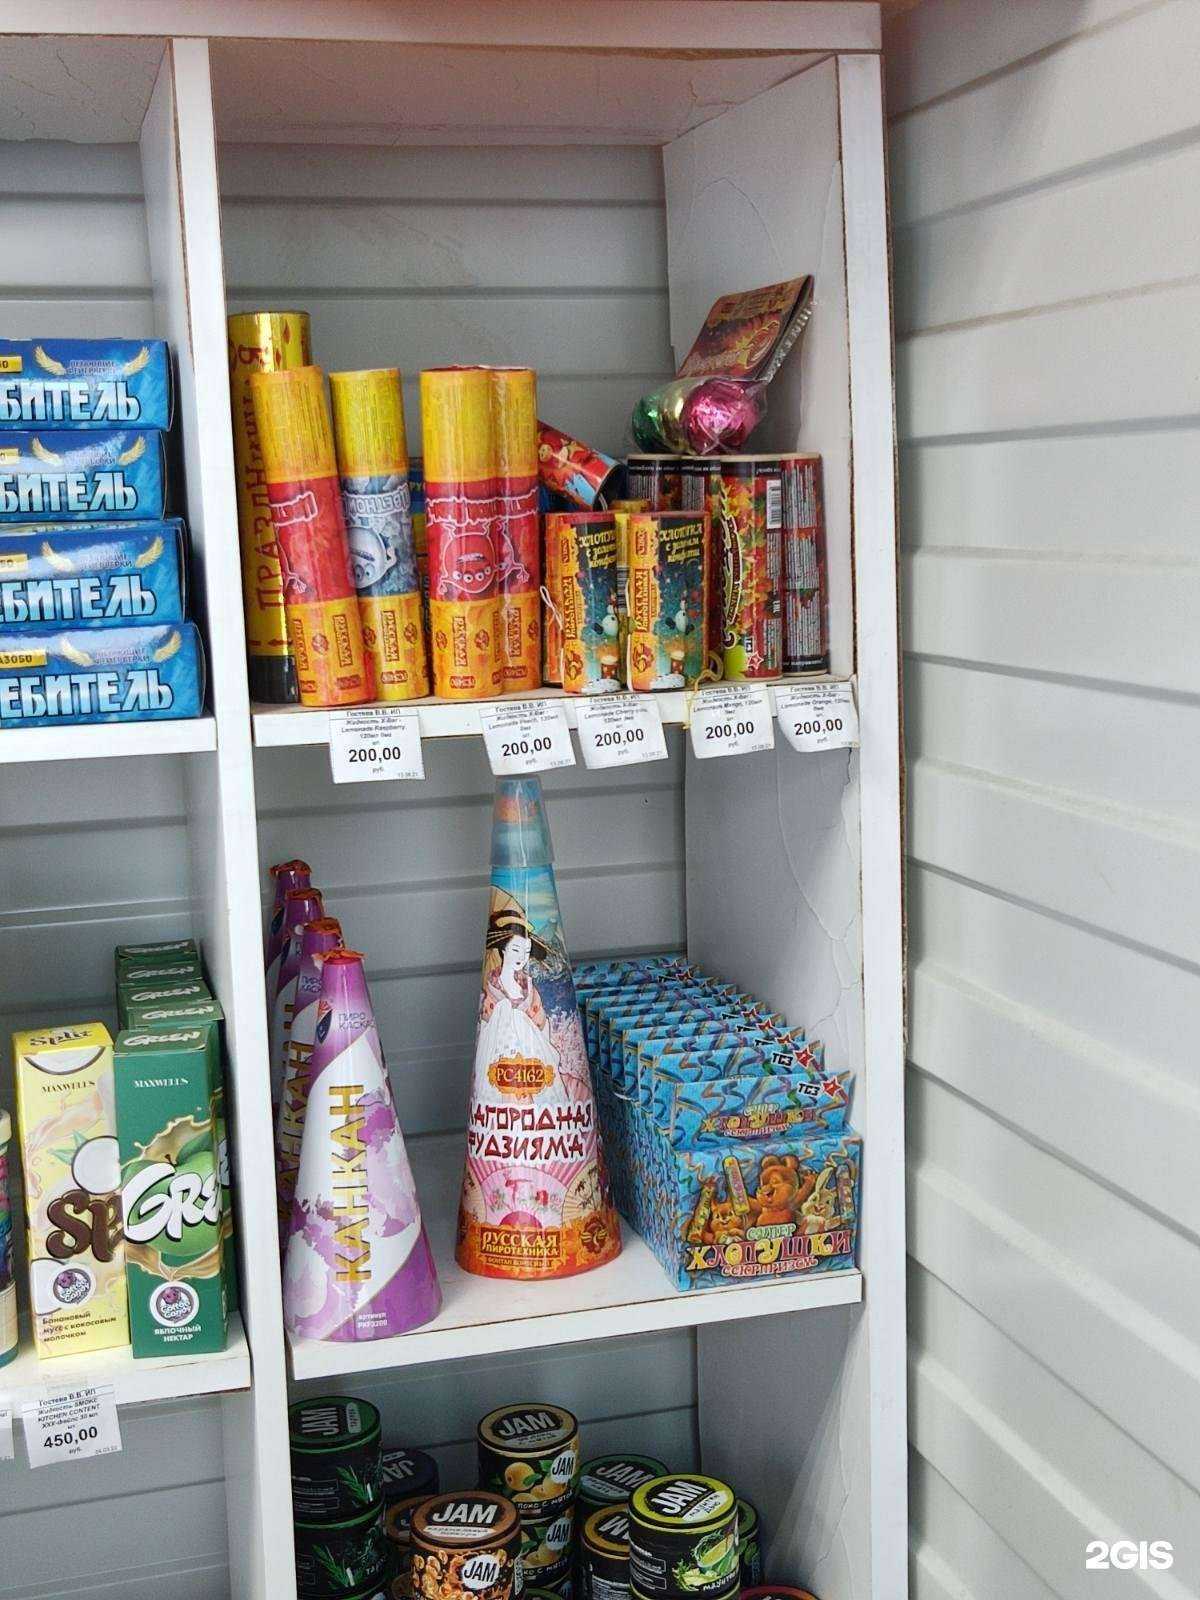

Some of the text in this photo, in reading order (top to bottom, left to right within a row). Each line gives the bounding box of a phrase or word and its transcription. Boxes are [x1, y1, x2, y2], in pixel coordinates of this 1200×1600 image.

[0, 574, 156, 623] БИТЕЛЬ
[705, 721, 754, 740] 200,00
[794, 718, 843, 736] 200,00
[501, 736, 552, 757] 200,00
[594, 728, 644, 747] 200,00
[349, 746, 401, 763] 200,00
[127, 966, 195, 979] GREEN
[131, 985, 200, 1002] GREEN
[142, 1005, 214, 1020] GREEN
[123, 1031, 201, 1047] GREEN
[329, 1084, 372, 1284] КАНКАН
[482, 1230, 559, 1251] РУССКАЯ
[486, 1243, 559, 1257] ПИРОТЕХНИКА
[301, 1407, 340, 1436] JAM
[499, 1412, 556, 1436] JAM
[43, 1426, 98, 1449] 450,00
[552, 1457, 574, 1476] JAM
[595, 1463, 656, 1489] JAM
[650, 1480, 708, 1514] JAM
[432, 1502, 498, 1524] JAM
[547, 1524, 570, 1543] JAM
[463, 1560, 498, 1582] JAM
